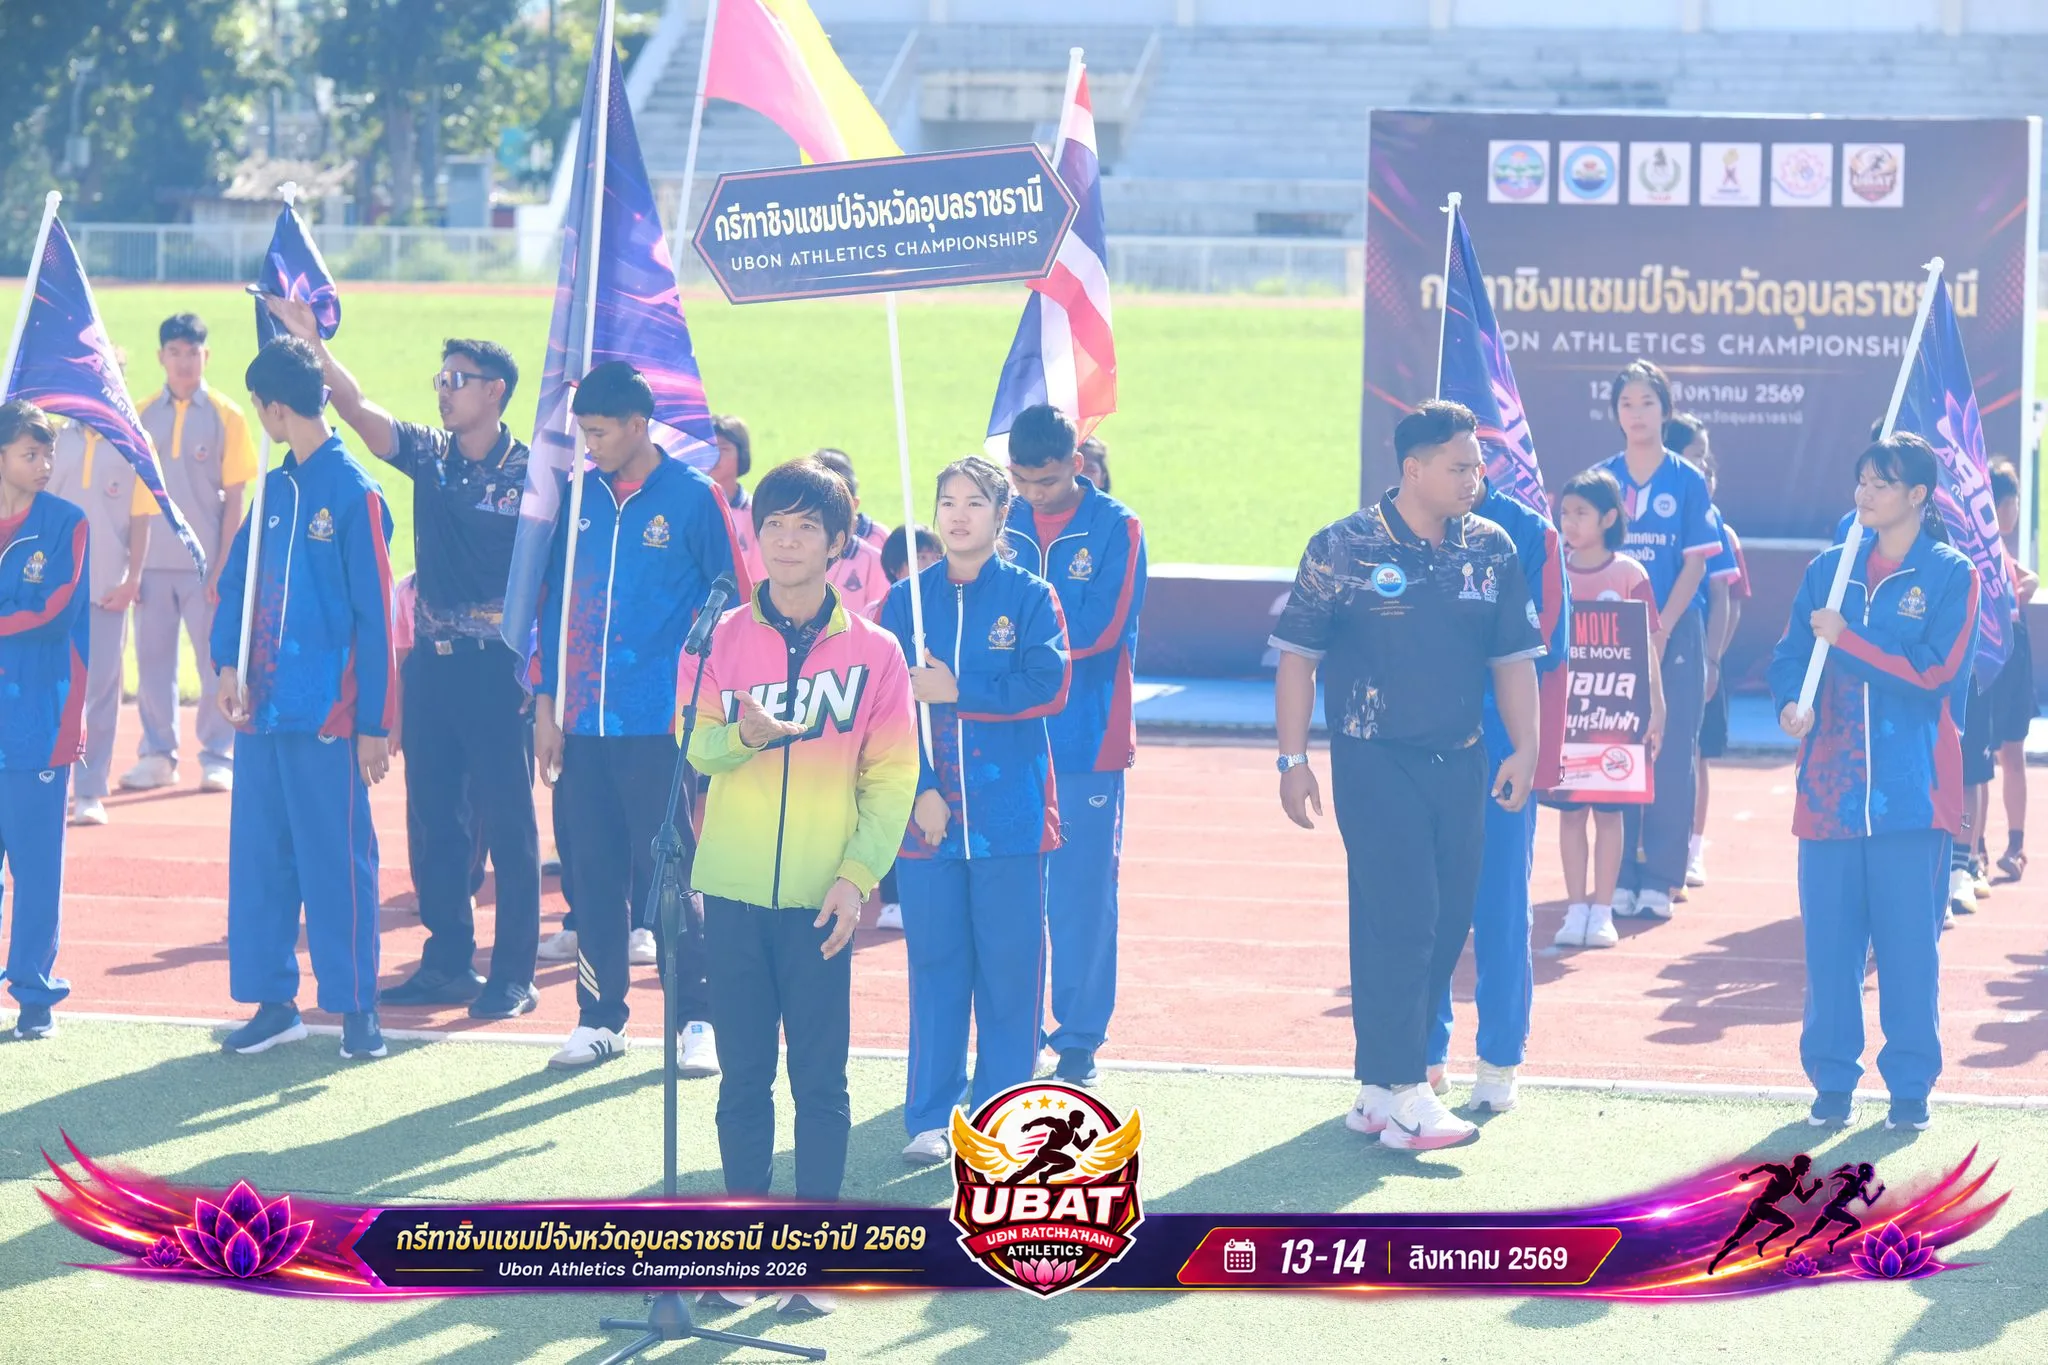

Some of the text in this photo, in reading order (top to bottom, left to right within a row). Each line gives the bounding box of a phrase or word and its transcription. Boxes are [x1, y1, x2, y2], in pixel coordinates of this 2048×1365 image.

[731, 230, 1038, 272] UBON ATHLETICS CHAMPIONSHIPS
[1502, 329, 1908, 357] ON ATHLETICS CHAMPIONSHI
[1755, 383, 1804, 403] 2569
[1575, 612, 1619, 646] MOVE
[1570, 646, 1632, 660] BE MOVE
